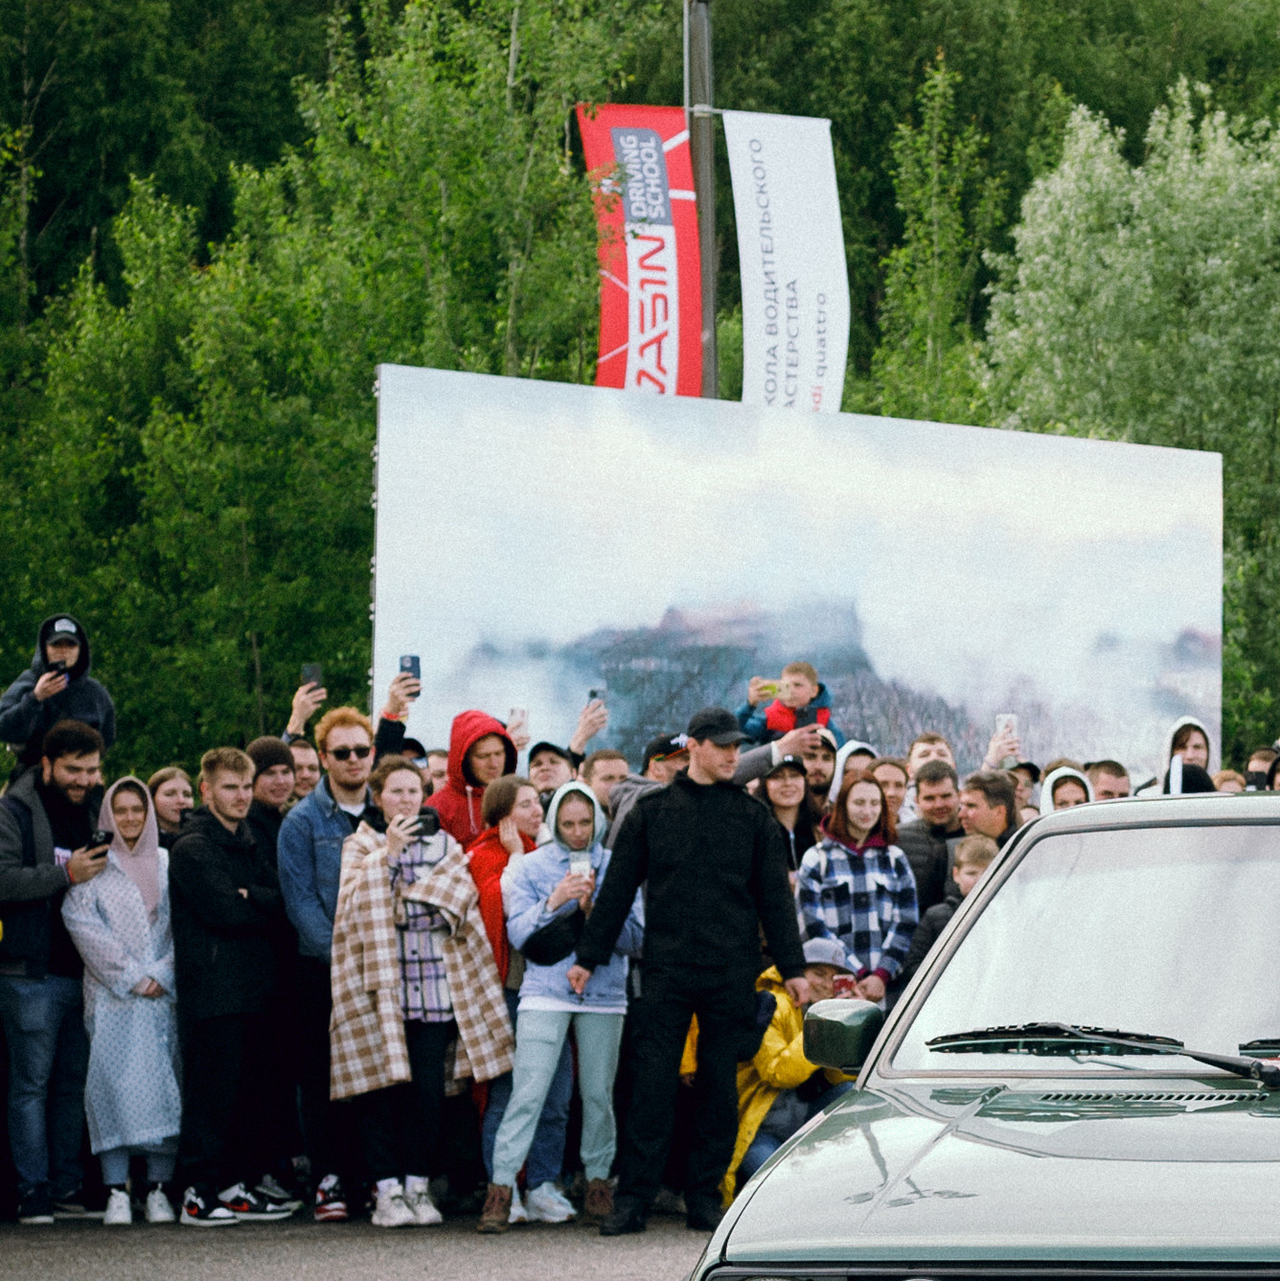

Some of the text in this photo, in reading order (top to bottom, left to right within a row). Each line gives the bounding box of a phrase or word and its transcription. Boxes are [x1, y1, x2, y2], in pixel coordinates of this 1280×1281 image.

[620, 135, 647, 217] DRIVING
[640, 136, 665, 218] SCHOOL
[749, 138, 779, 335] ВОДИТЕЛЬСКОГО
[816, 292, 827, 377] quattro
